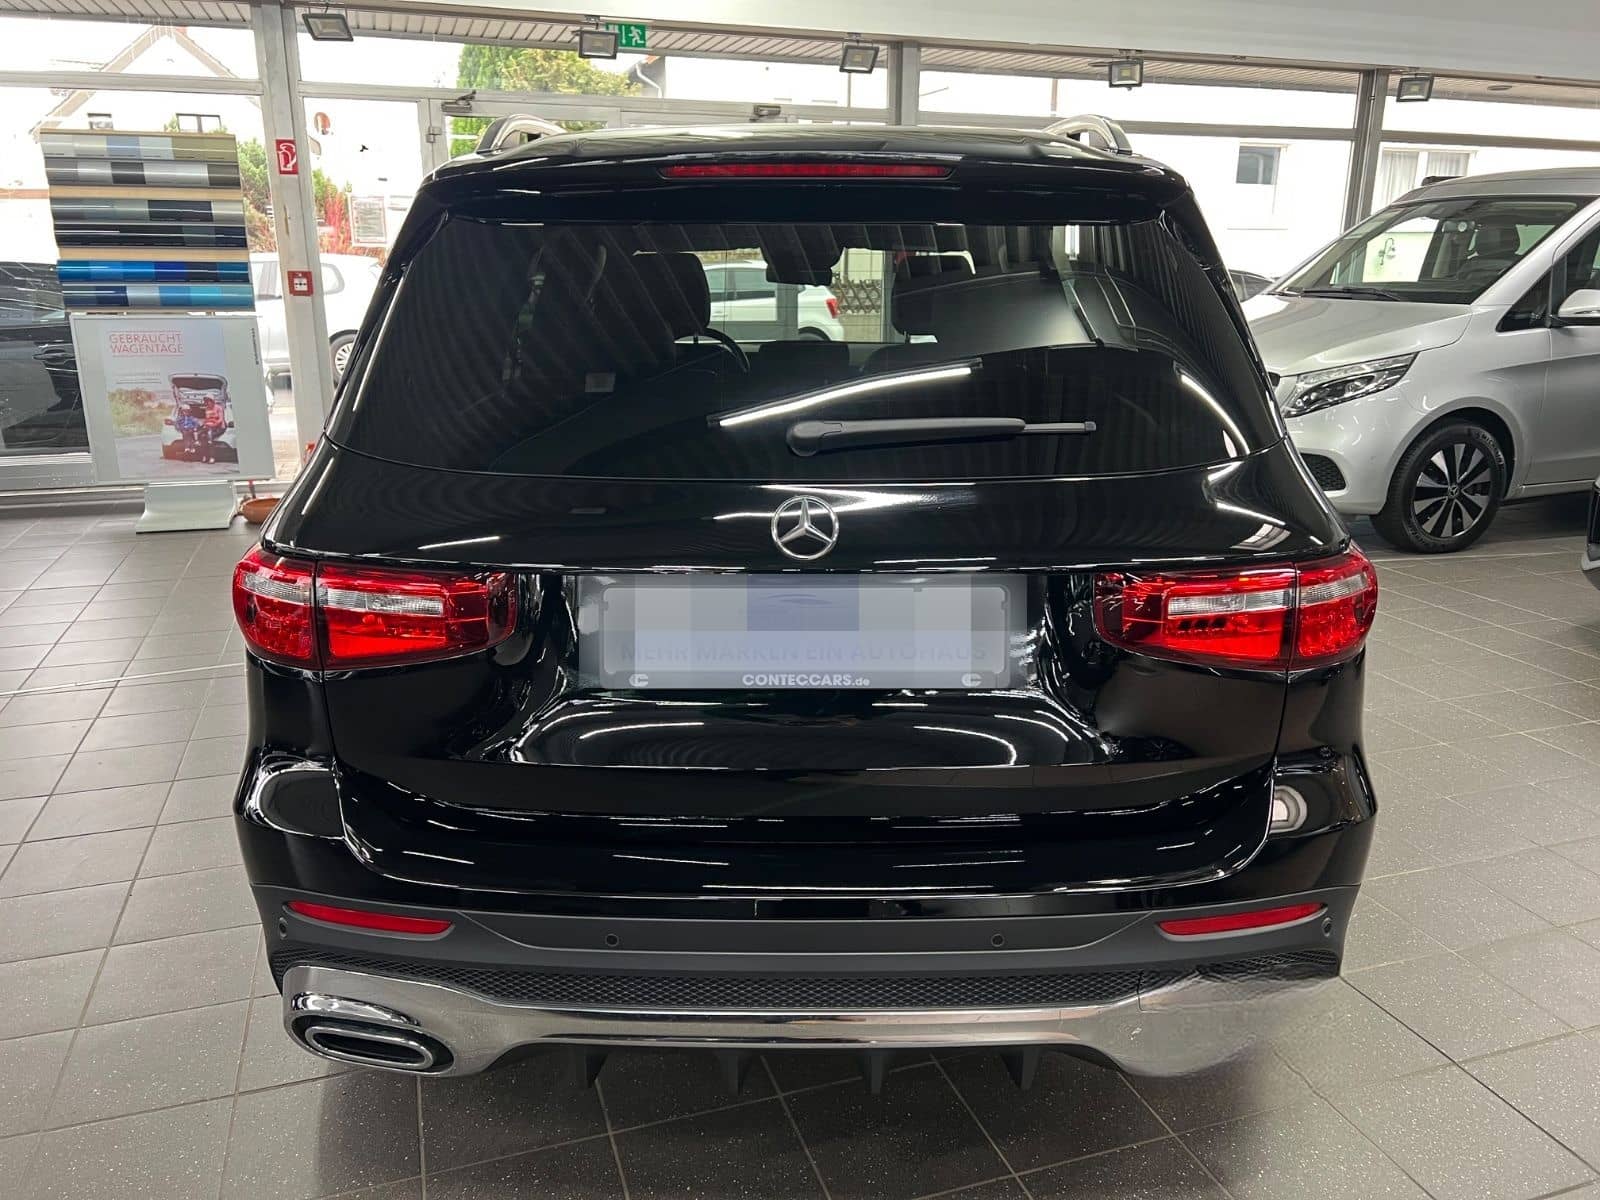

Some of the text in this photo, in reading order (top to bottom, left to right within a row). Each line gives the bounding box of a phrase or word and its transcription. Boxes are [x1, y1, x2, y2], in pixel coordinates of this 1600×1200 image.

[110, 333, 182, 343] GEBRAUCHT
[111, 343, 183, 353] WAGENTAGE
[742, 673, 871, 687] CONTECCARS.de
